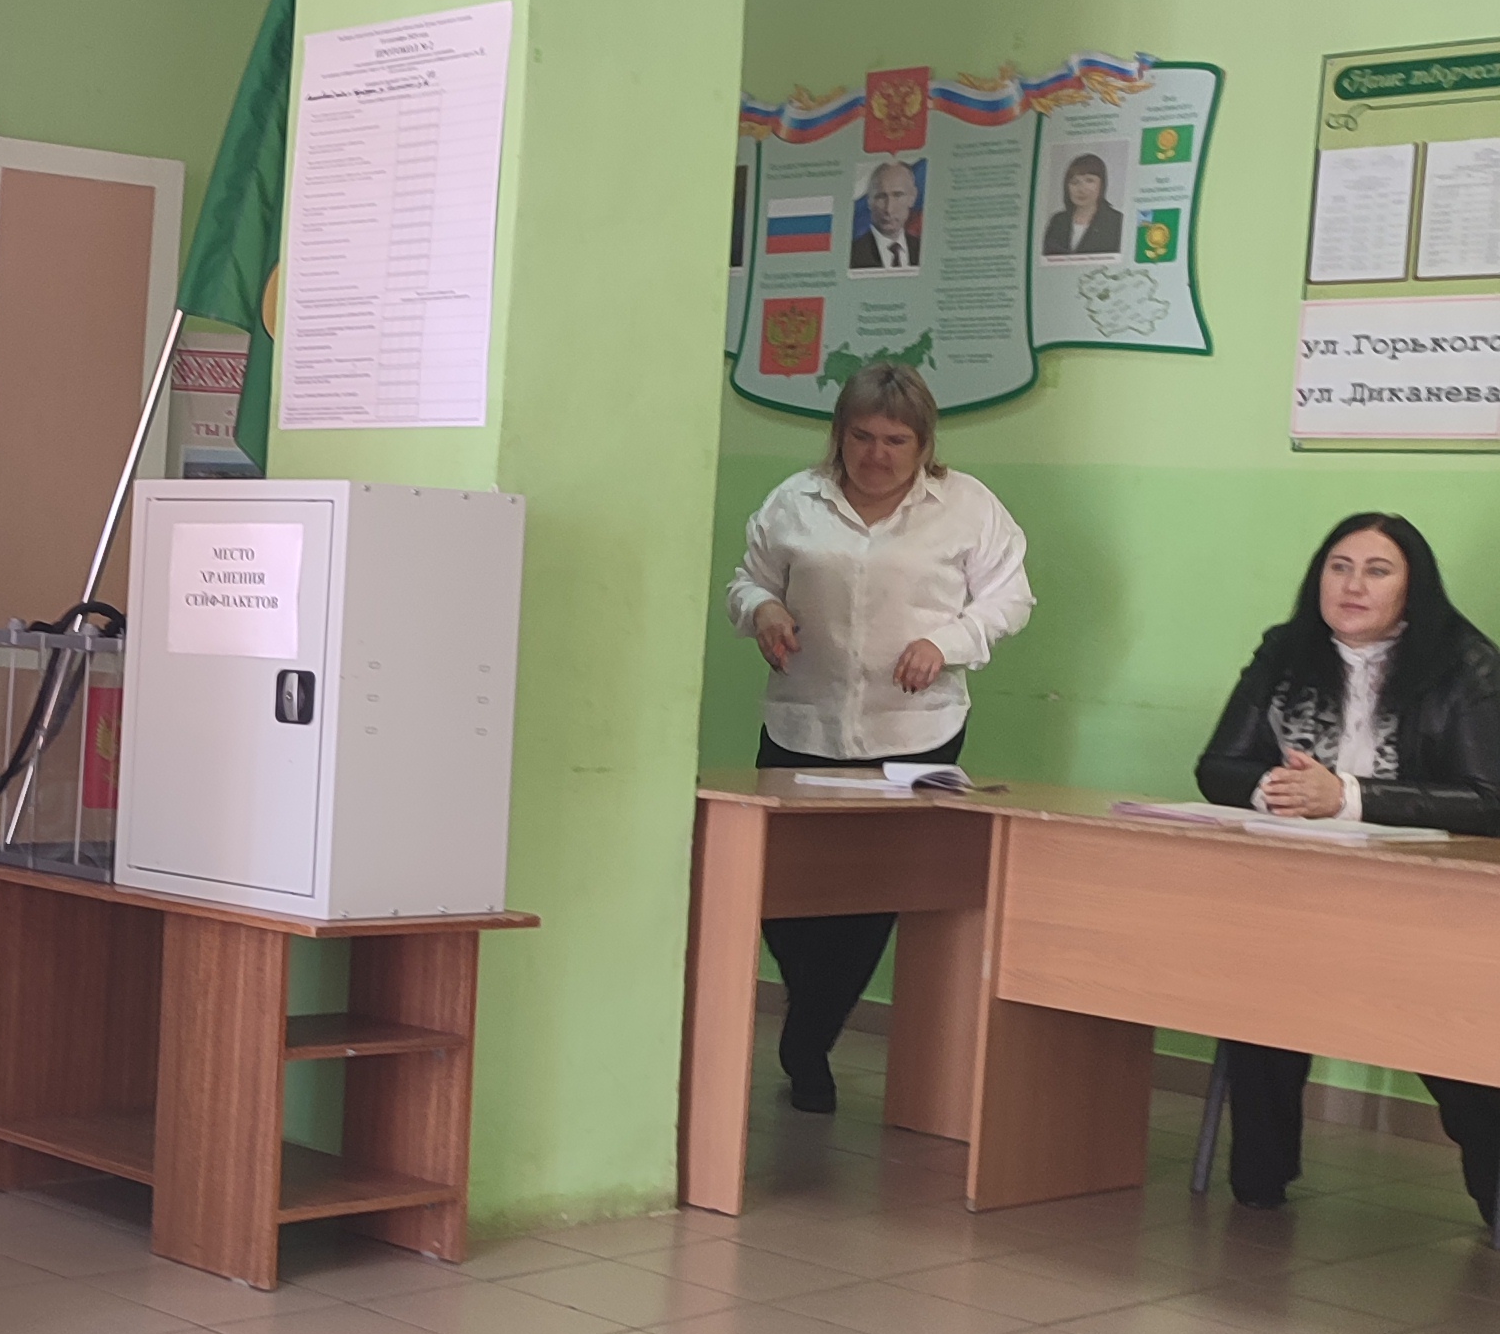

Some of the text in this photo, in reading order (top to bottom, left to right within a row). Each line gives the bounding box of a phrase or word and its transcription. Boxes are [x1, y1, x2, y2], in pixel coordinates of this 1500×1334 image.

[212, 547, 255, 562] МЕСТО
[199, 569, 266, 586] ХРАНЕНИЯ
[185, 590, 279, 610] СЕЙФ-ПАКЕТОВ
